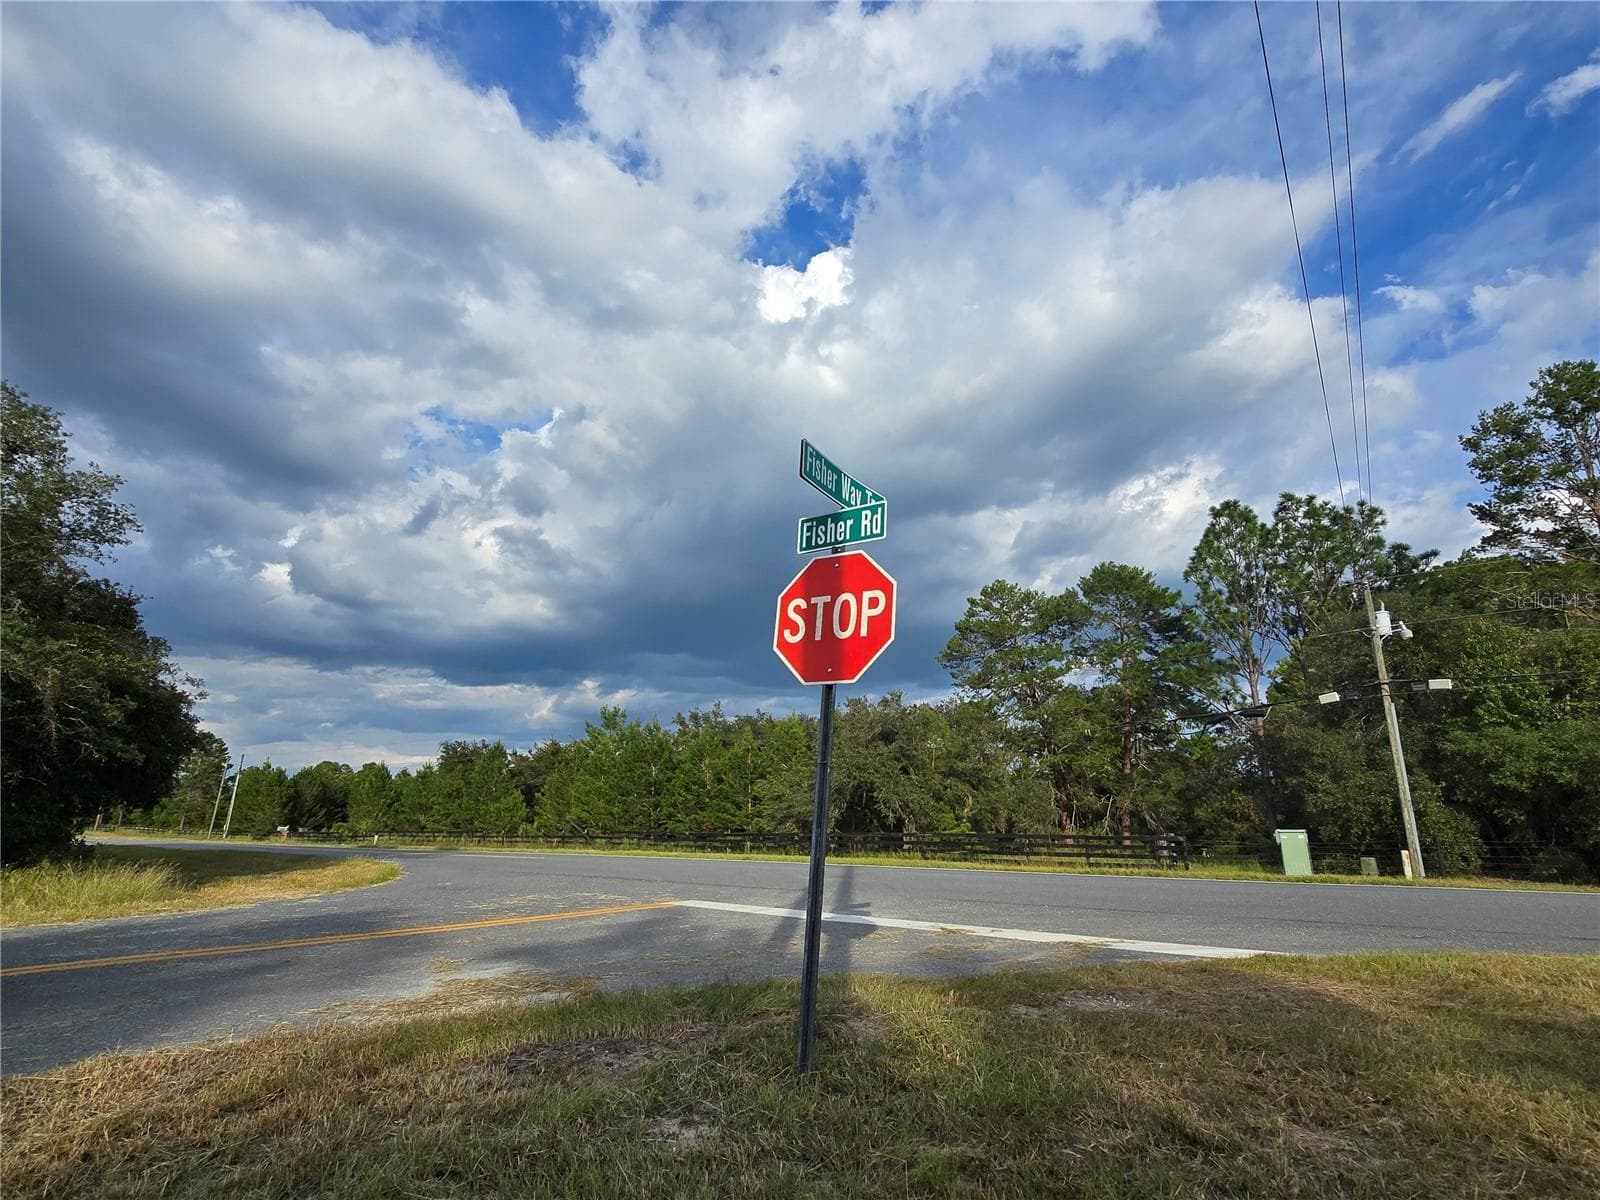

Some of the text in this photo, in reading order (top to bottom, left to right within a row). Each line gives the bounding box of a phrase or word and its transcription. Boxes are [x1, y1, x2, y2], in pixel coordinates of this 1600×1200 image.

[806, 446, 838, 493] Fisher
[841, 473, 862, 506] Way
[801, 507, 882, 548] Fisher Rd
[783, 589, 887, 644] STOP
